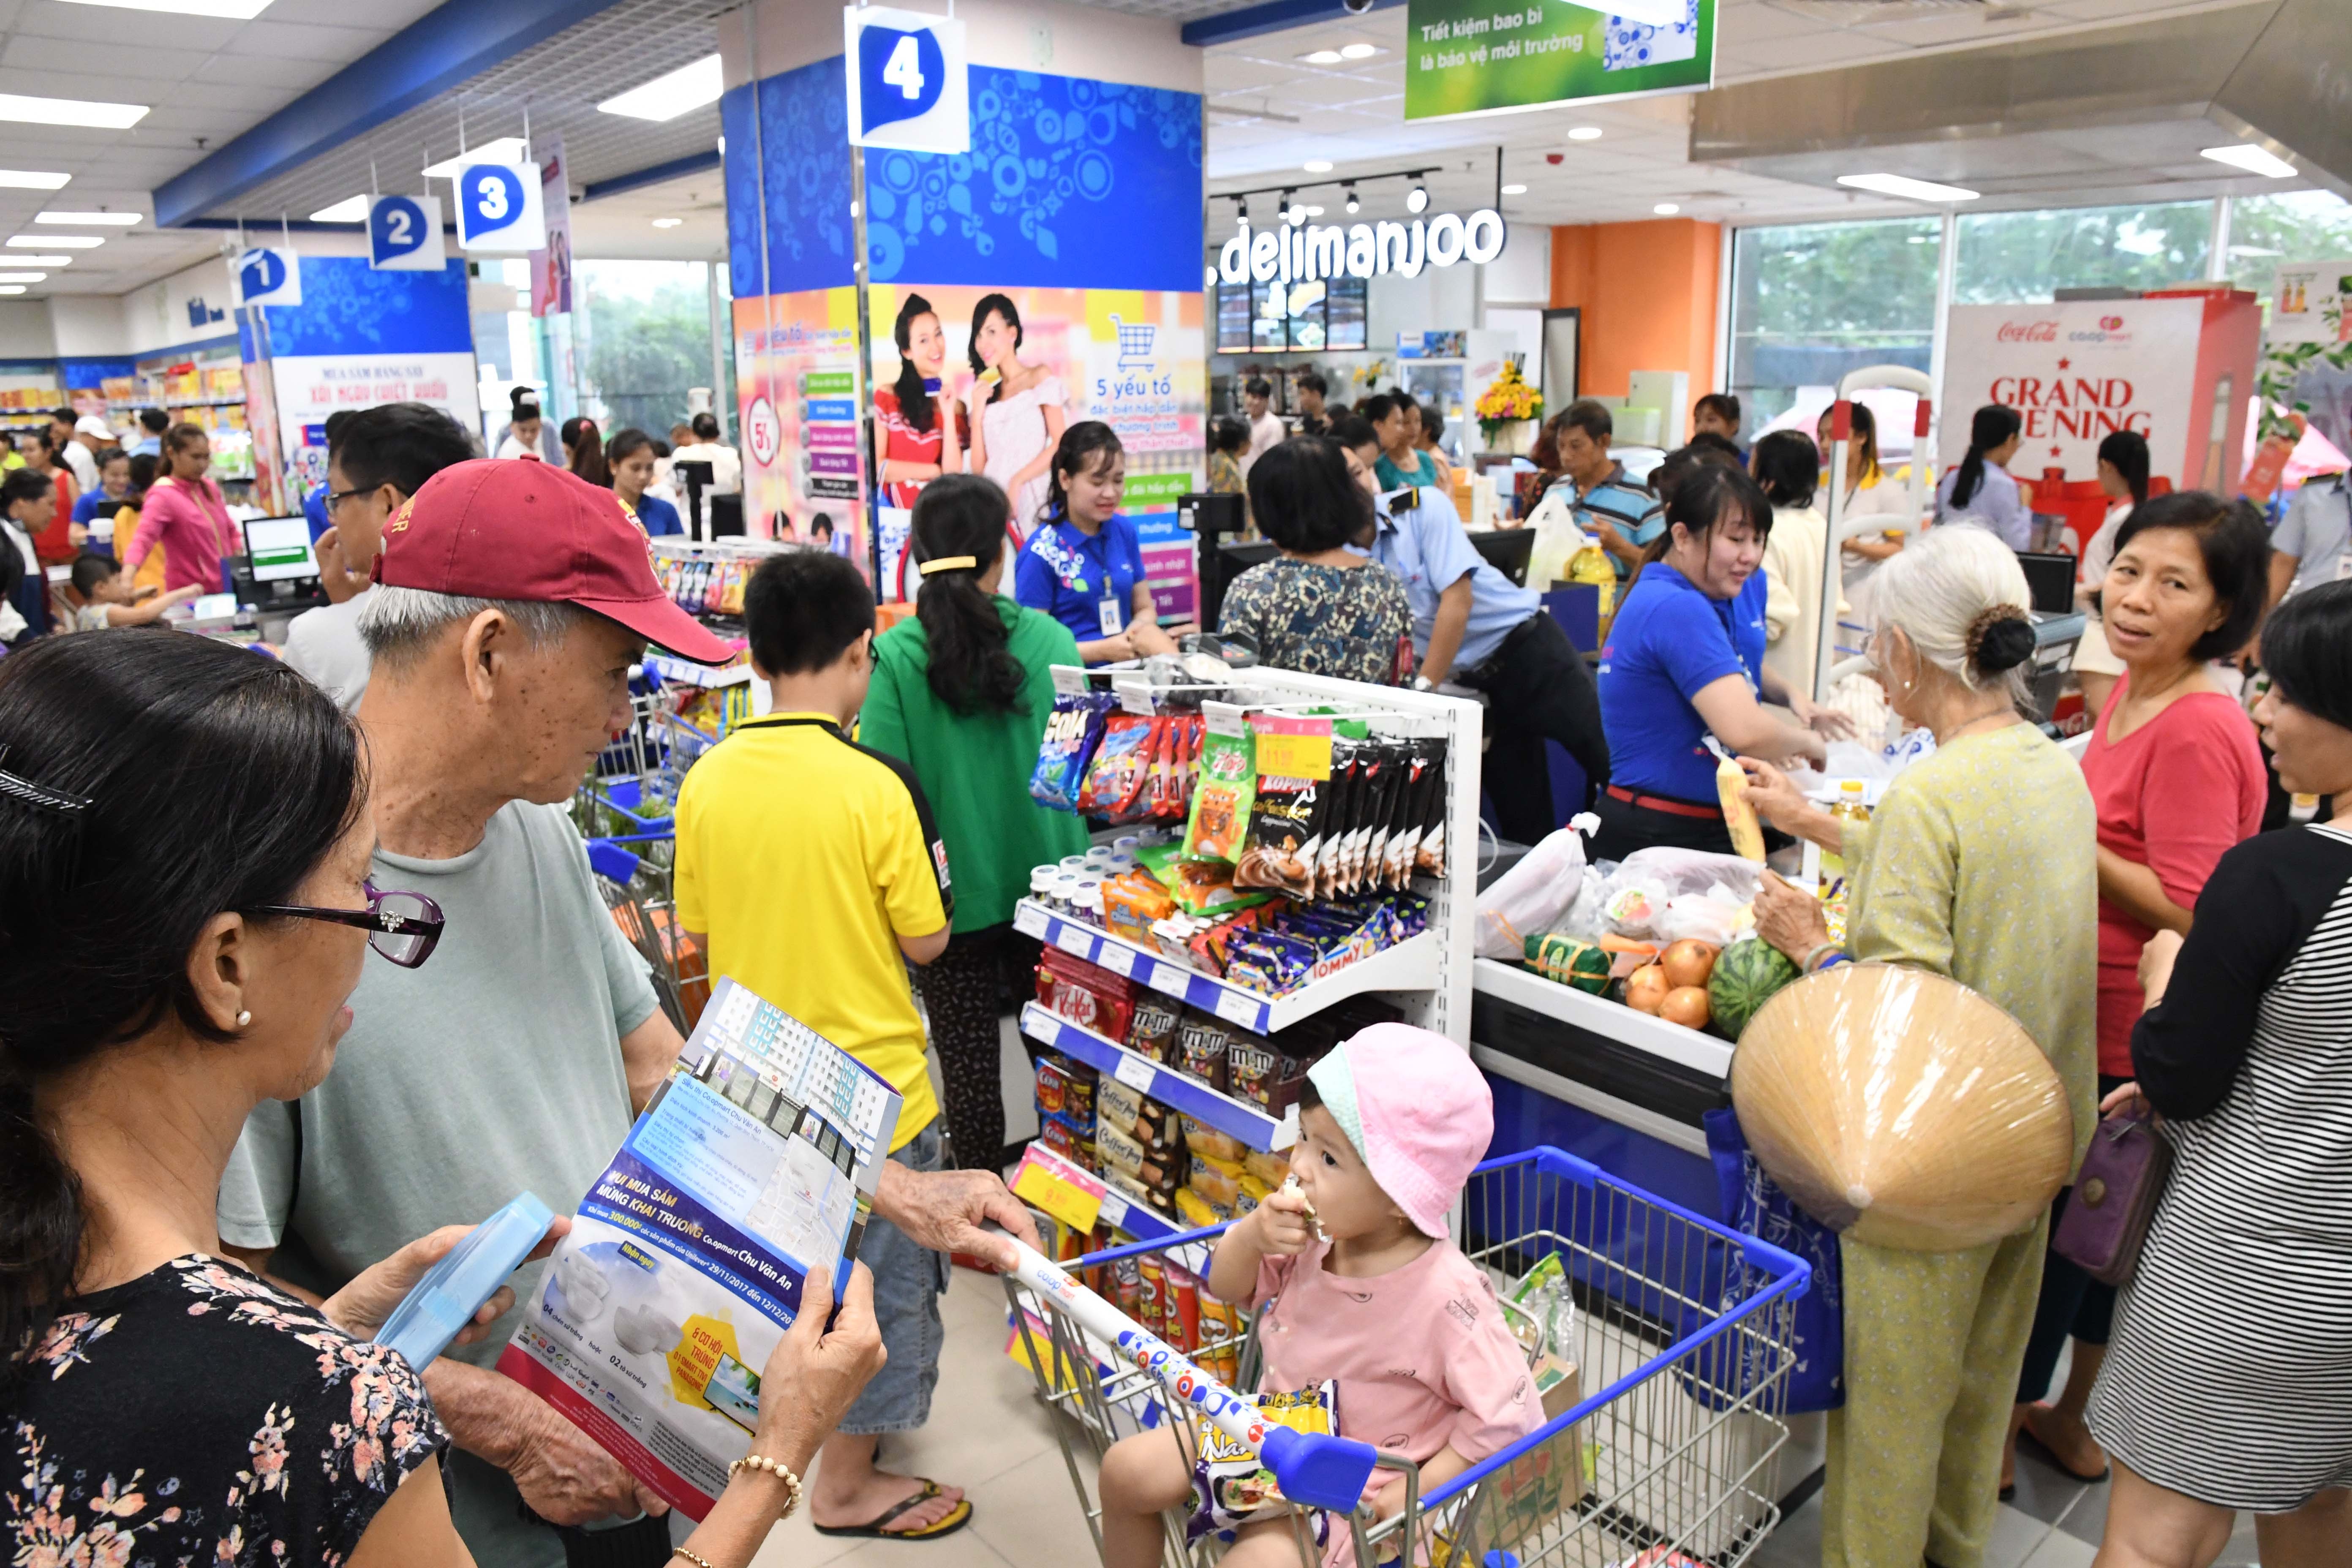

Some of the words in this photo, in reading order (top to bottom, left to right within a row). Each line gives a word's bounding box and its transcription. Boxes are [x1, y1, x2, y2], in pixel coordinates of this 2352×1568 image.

[1422, 24, 1450, 42] Tiết
[1452, 19, 1489, 38] kiệm
[1493, 13, 1523, 32] bao
[1527, 8, 1542, 24] bì
[1420, 53, 1434, 71] là
[1437, 47, 1465, 68] bảo
[1470, 47, 1488, 67] vệ
[1492, 40, 1521, 60] môi
[1525, 32, 1584, 56] trường
[884, 36, 924, 99] 4
[478, 177, 509, 219] 3
[387, 210, 414, 245] 2
[256, 259, 270, 286] 1
[1097, 379, 1106, 396] 5
[1114, 373, 1146, 400] yếu
[1153, 373, 1171, 395] tố
[1990, 377, 2133, 408] GRAND
[2020, 409, 2152, 441] ENING
[702, 1092, 732, 1113] Co.opmart
[730, 1109, 743, 1122] Chu
[741, 1117, 755, 1129] Văn
[752, 1124, 763, 1135] An
[626, 1177, 651, 1196] MUA
[650, 1185, 678, 1207] SẮM
[596, 1208, 609, 1219] mua
[709, 1263, 748, 1293] 29/11/2017
[746, 1286, 763, 1301] đến
[620, 1242, 641, 1260] Nhận
[637, 1253, 656, 1270] ngay
[628, 1198, 655, 1218] KHAI
[703, 1234, 739, 1258] Co.opmart
[737, 1250, 759, 1268] Chu
[757, 1261, 779, 1280] Văn
[776, 1273, 793, 1290] An
[542, 1304, 555, 1316] 04
[550, 1312, 566, 1326] chén
[586, 1341, 603, 1355] hoặc
[691, 1326, 701, 1339] &
[705, 1337, 725, 1357] HỘI
[608, 1354, 622, 1368] 02
[672, 1350, 682, 1361] 01
[680, 1356, 699, 1375] SMART
[691, 1345, 716, 1370] TRÚNG
[676, 1366, 704, 1392] PANASONIC
